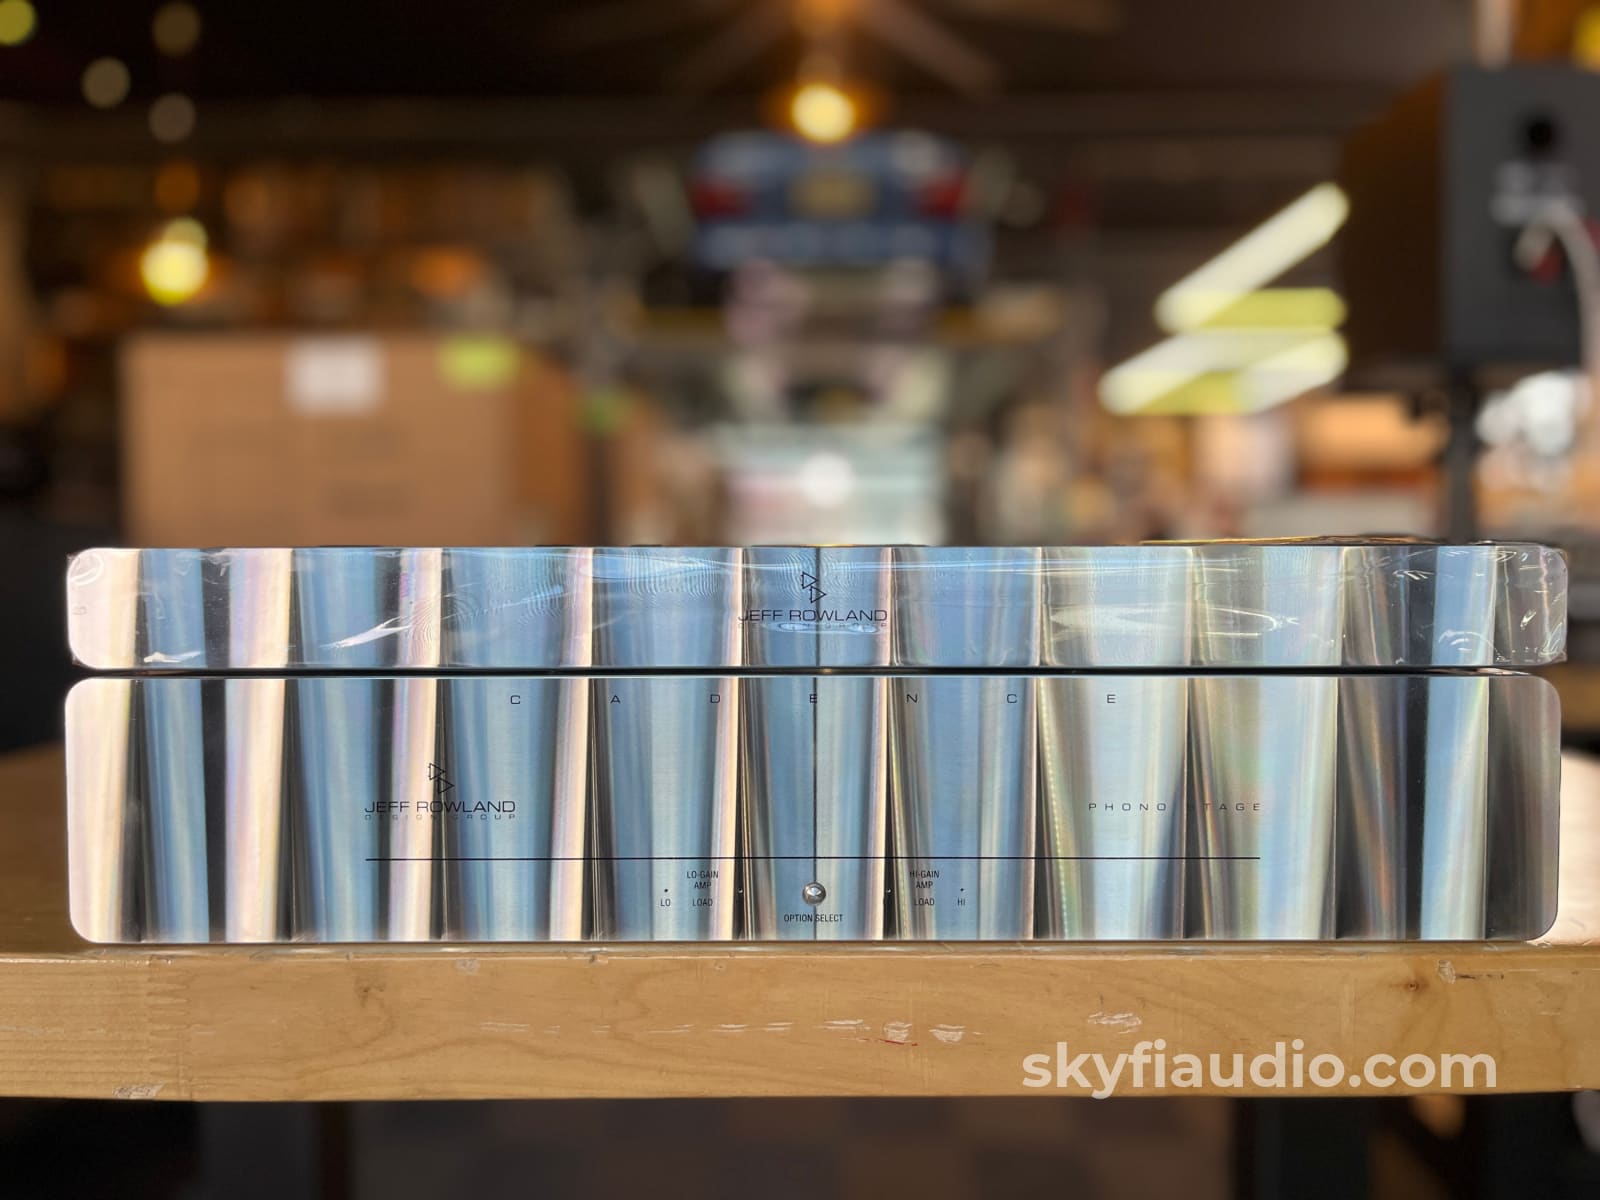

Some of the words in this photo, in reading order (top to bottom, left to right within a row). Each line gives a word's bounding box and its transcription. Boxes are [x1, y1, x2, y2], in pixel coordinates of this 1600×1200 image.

[738, 609, 784, 622] JEFF
[789, 609, 888, 622] ROWLAND
[364, 801, 410, 813] JEFF
[416, 801, 516, 813] ROWLAND
[1088, 803, 1167, 811] PHONO
[1182, 803, 1262, 811] TAGE
[686, 870, 719, 879] LO-GAIN
[909, 870, 940, 879] HI-GAIN
[694, 881, 712, 889] AMP
[915, 881, 934, 889] AMP
[660, 898, 671, 907] LO
[692, 898, 713, 907] LOAD
[913, 898, 935, 906] LOAD
[957, 898, 966, 906] HI
[783, 913, 813, 922] OPTION
[815, 913, 844, 922] SELECT
